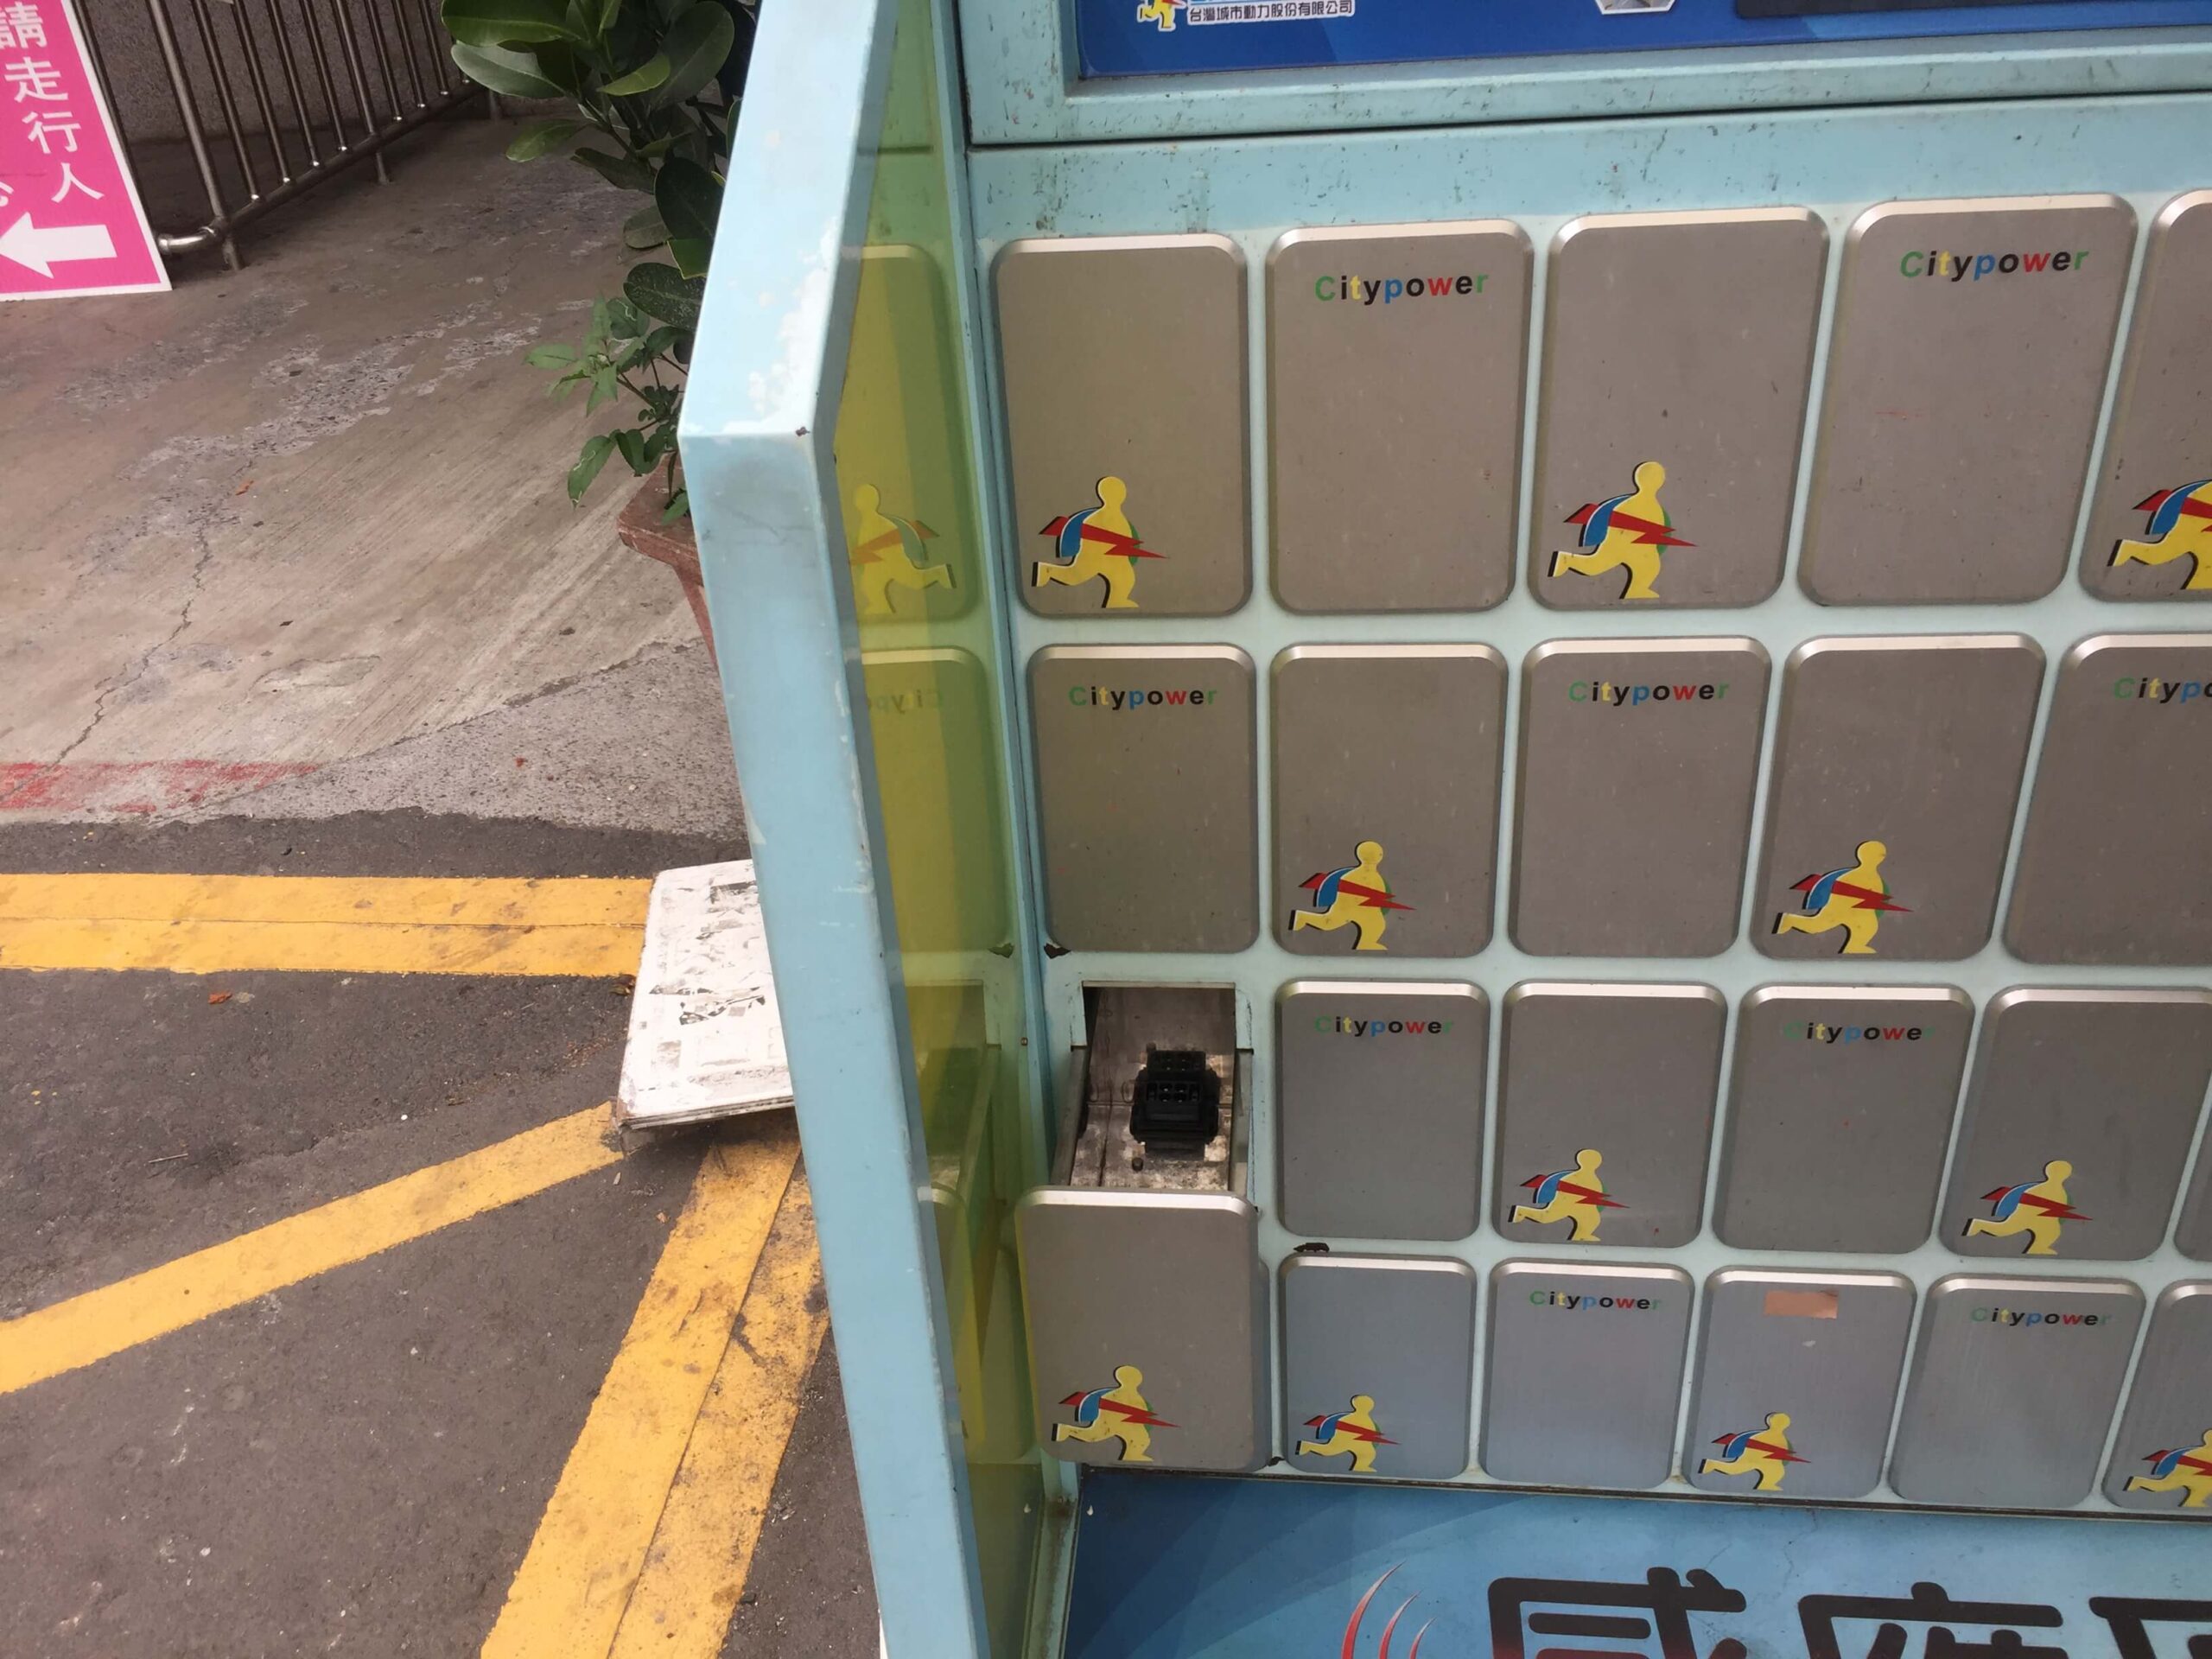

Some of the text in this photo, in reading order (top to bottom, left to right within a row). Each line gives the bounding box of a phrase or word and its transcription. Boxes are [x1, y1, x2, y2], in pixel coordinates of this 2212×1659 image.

[1899, 250, 2089, 283] Citypower
[1314, 273, 1489, 305] Citypower
[1069, 685, 1217, 710] Citypower
[1567, 679, 1729, 707] Citypower
[1314, 1015, 1453, 1037] Citypower
[1783, 1020, 1936, 1045] Citypower
[1529, 1290, 1661, 1311] Citypower
[1971, 1306, 2111, 1327] Citypower
